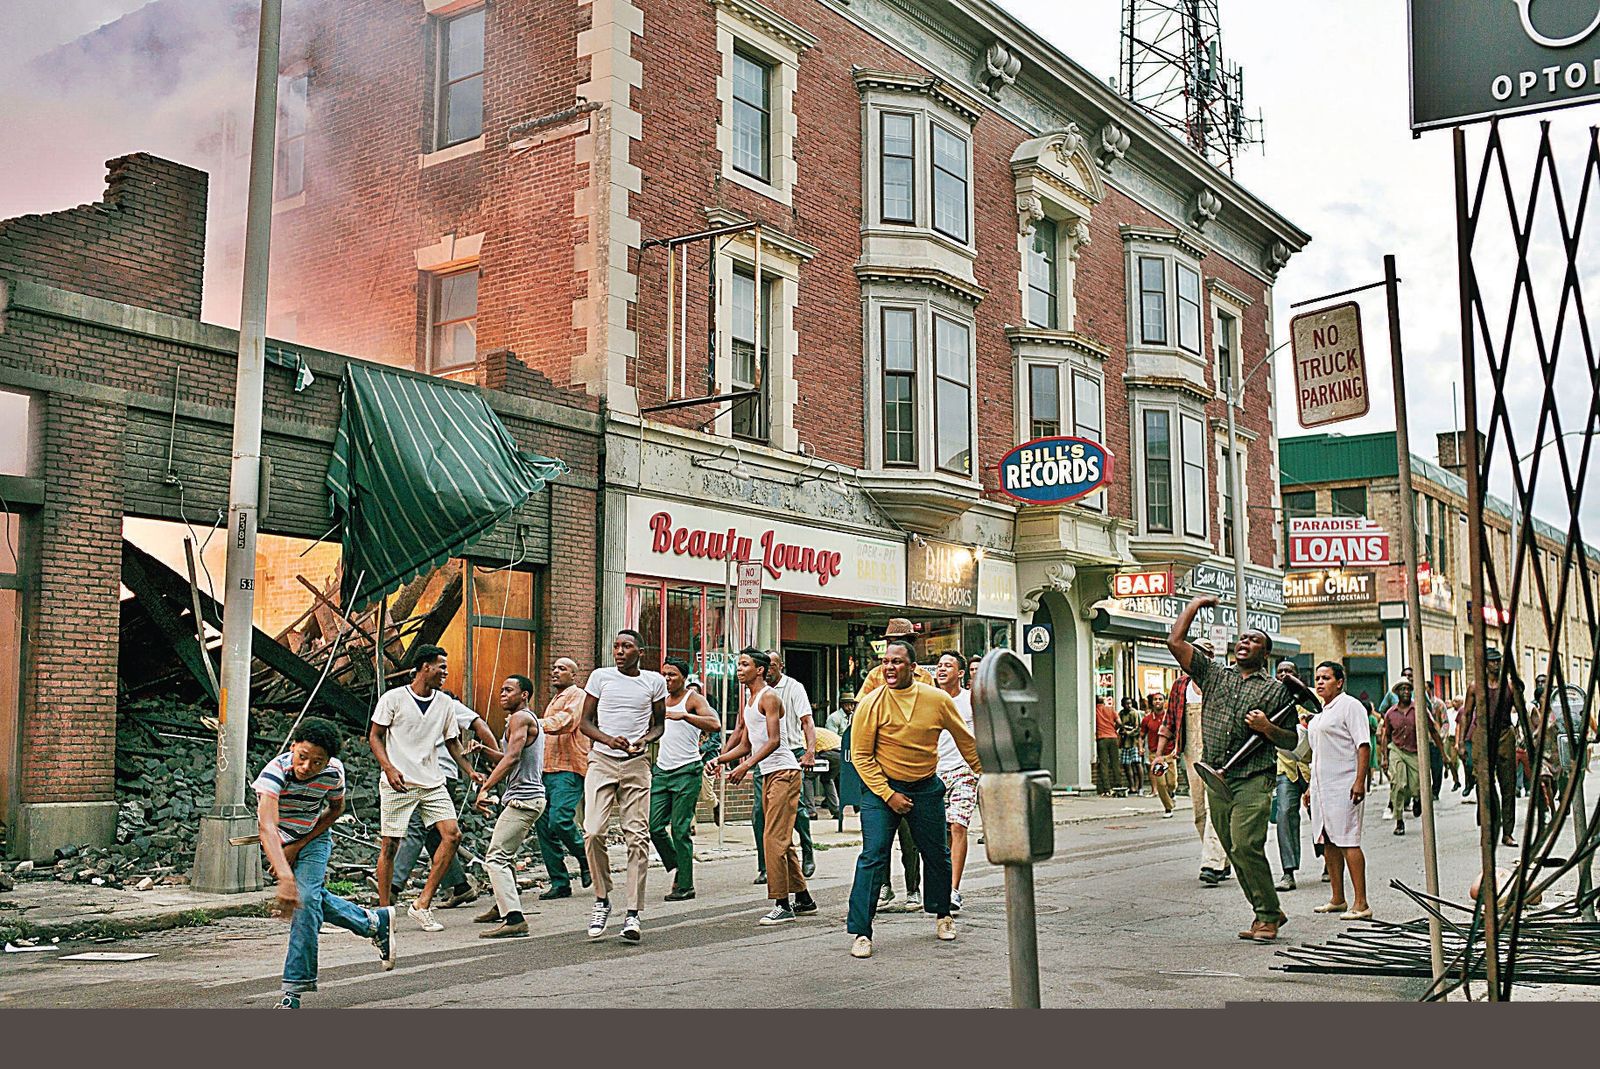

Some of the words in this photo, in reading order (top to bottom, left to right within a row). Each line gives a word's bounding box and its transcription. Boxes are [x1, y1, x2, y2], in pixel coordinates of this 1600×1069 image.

[1313, 324, 1339, 350] NO
[1300, 348, 1359, 380] TRUCK
[1301, 376, 1362, 410] PARKING
[1020, 443, 1085, 464] BILL'S
[1006, 456, 1100, 490] RECORDS
[238, 513, 246, 549] 5385
[1293, 521, 1362, 531] PARADISE
[649, 511, 753, 564] Beauty
[760, 530, 842, 587] Lounge
[1295, 537, 1383, 561] LOANS
[745, 568, 755, 577] NO
[1117, 574, 1165, 594] BAR
[1196, 567, 1215, 585] Save
[911, 581, 943, 605] RECORDS
[947, 587, 972, 607] BOOKS
[1283, 578, 1320, 597] CHIT
[1324, 575, 1369, 595] CHAT
[1284, 595, 1330, 604] NTERTAINMENT
[1336, 593, 1370, 602] COCKTAILS
[1121, 597, 1178, 618] PARADISE
[1182, 602, 1214, 624] LANS
[1255, 614, 1278, 632] GOLD
